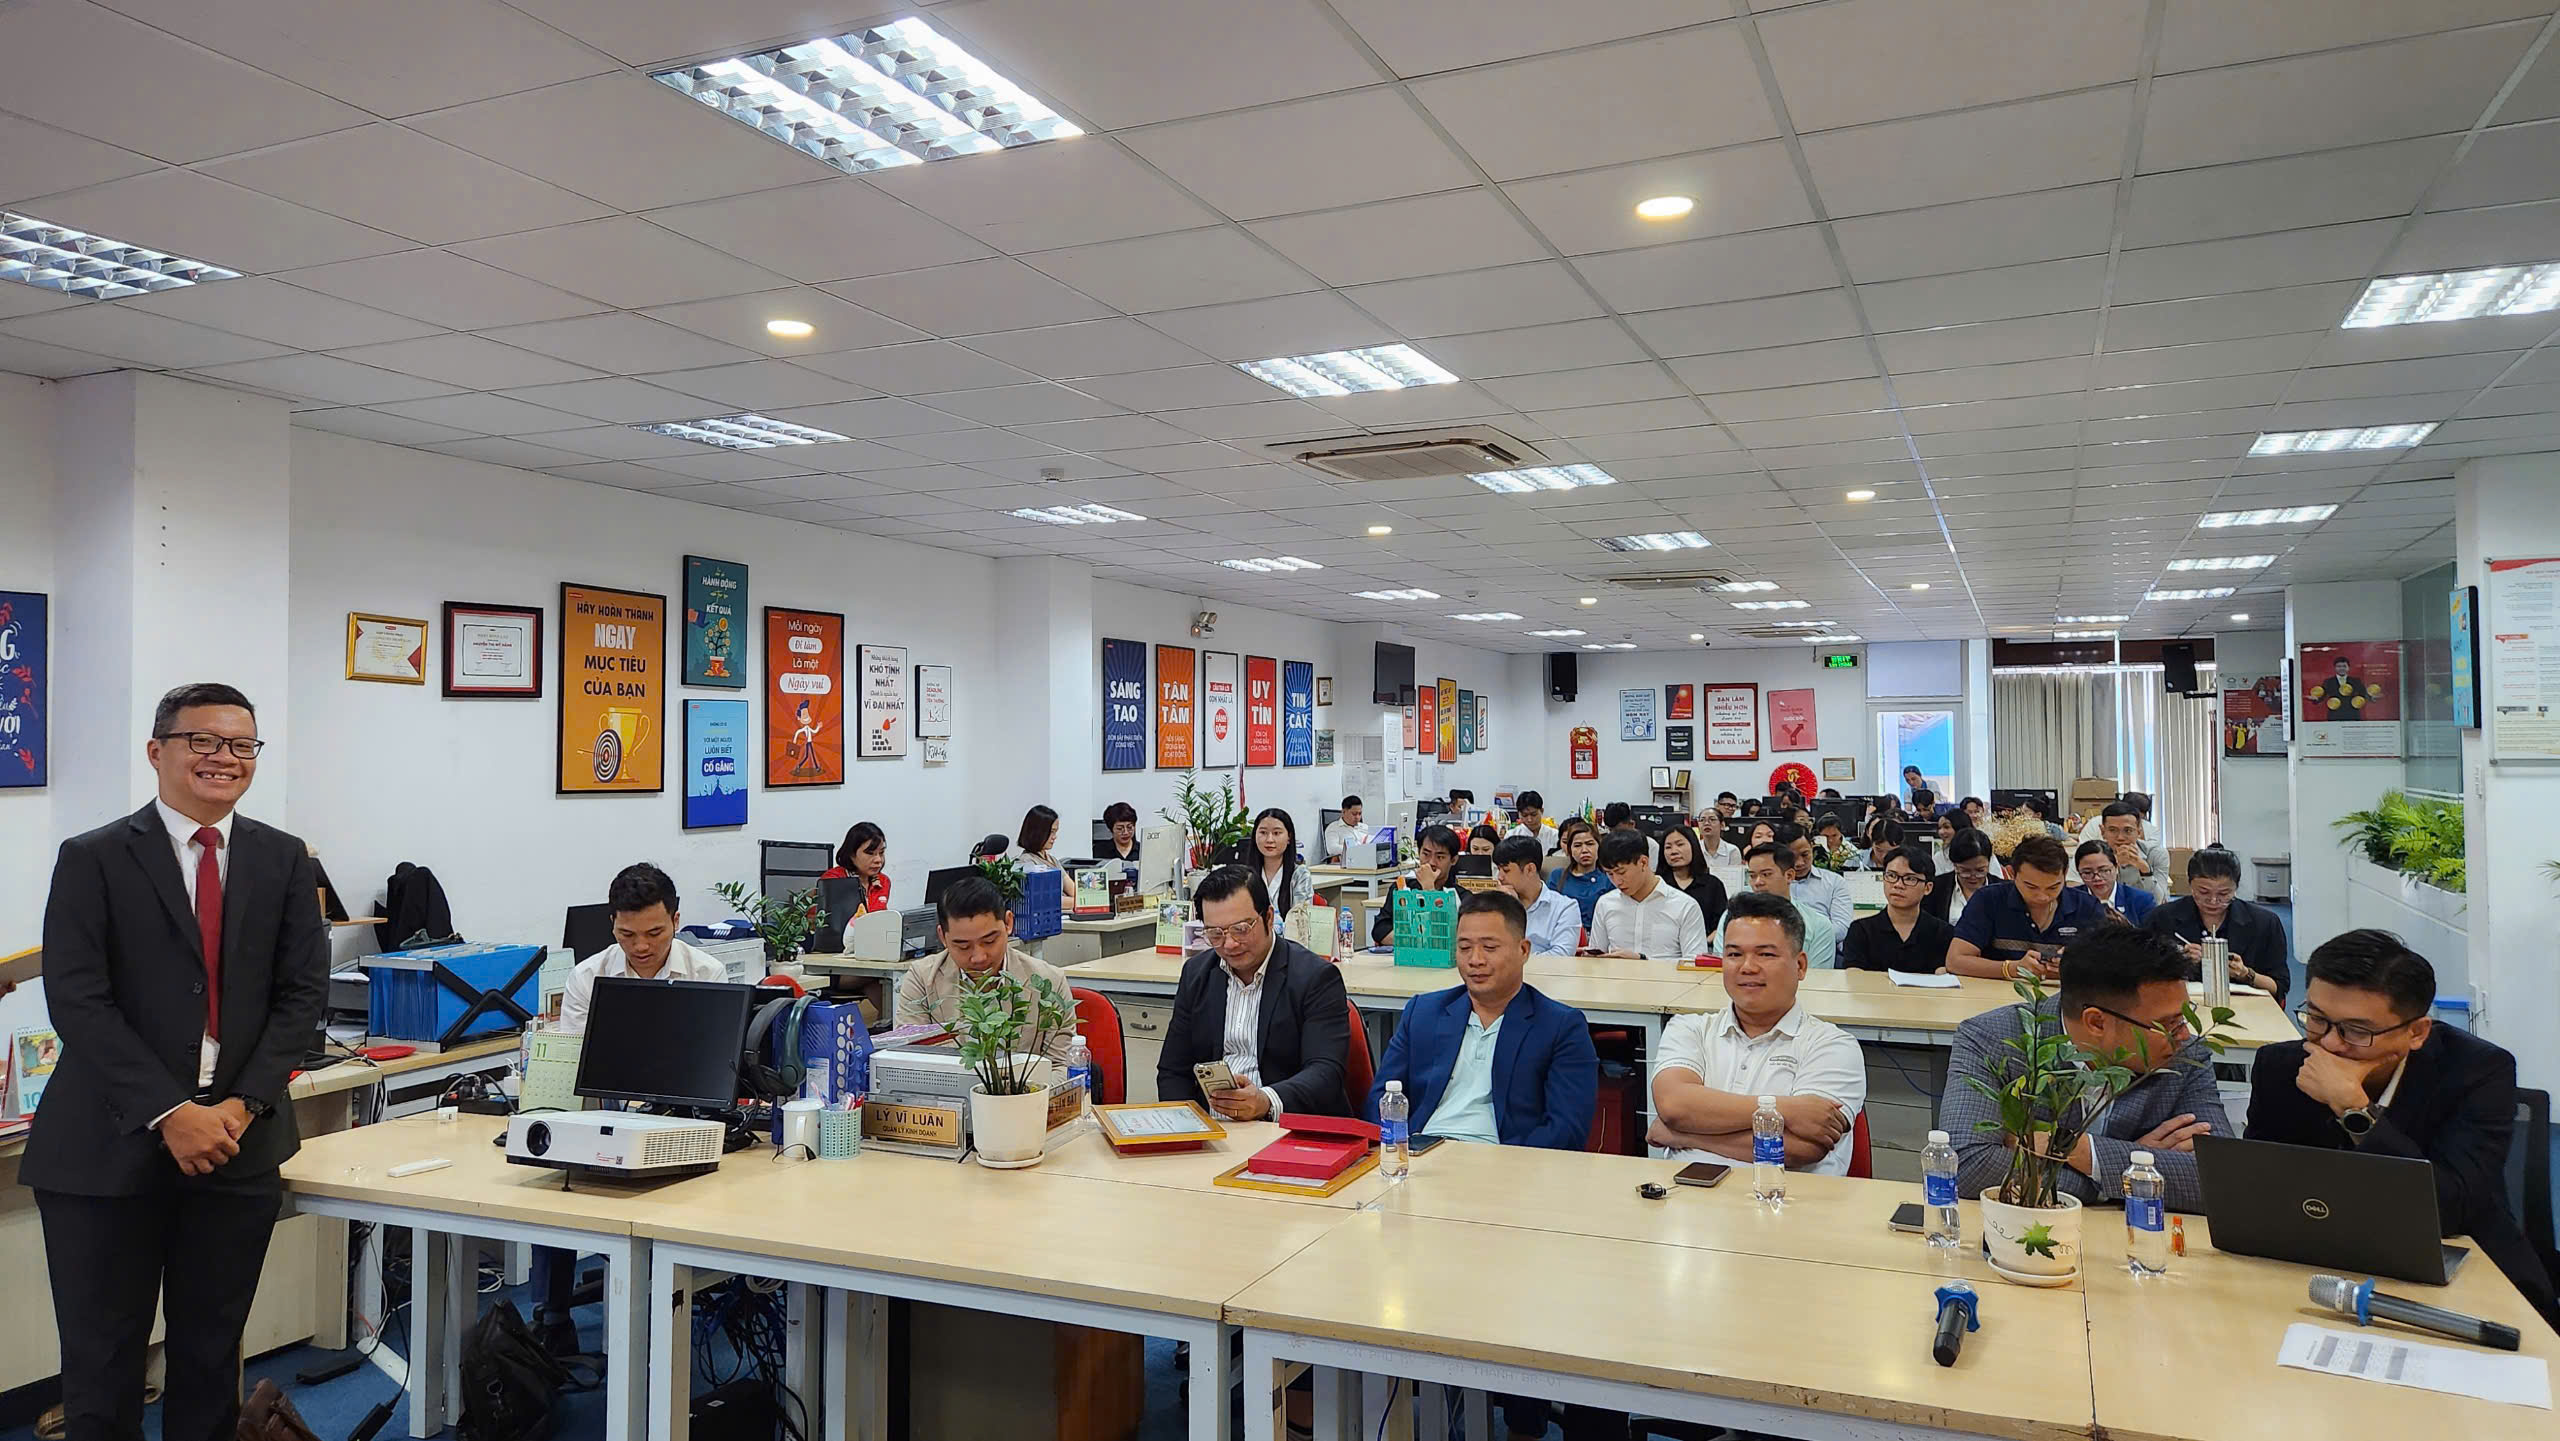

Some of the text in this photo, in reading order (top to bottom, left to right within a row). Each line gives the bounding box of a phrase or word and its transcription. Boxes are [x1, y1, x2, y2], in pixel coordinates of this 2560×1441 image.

[702, 575, 737, 590] HÀNH ĐỘNG
[576, 601, 654, 621] HÃY HOÀN THÀNH
[706, 603, 732, 616] KẾT QUẢ
[804, 622, 823, 635] ngày
[594, 623, 637, 650] NGAY
[804, 641, 817, 650] làm
[584, 655, 646, 673] MỤC TIÊU
[793, 658, 819, 671] Là một
[869, 663, 900, 674] KHÓ TÍNH
[584, 677, 645, 700] CỦA BẠN
[788, 677, 824, 691] Ngày vui
[875, 675, 894, 687] NHẤT
[1110, 678, 1140, 699] SÁNG
[1163, 681, 1188, 703] TẬN
[1252, 680, 1271, 700] UY
[864, 697, 904, 712] VĨ ĐẠI NHẤT
[1291, 693, 1306, 708] TIN
[1113, 704, 1138, 726] TẠO
[1161, 704, 1189, 724] TÂM
[1251, 702, 1272, 725] TÍN
[1289, 711, 1308, 731] CẬY
[705, 744, 733, 755] LUÔN BIẾT
[704, 760, 734, 772] CỐ GẮNG
[1147, 832, 1160, 840] acer
[536, 1043, 547, 1058] 11
[876, 1108, 944, 1127] LÝ VĨ LUÂN
[883, 1125, 897, 1133] QUẢN
[919, 1129, 937, 1137] DOANH
[2306, 1205, 2326, 1213] DELL
